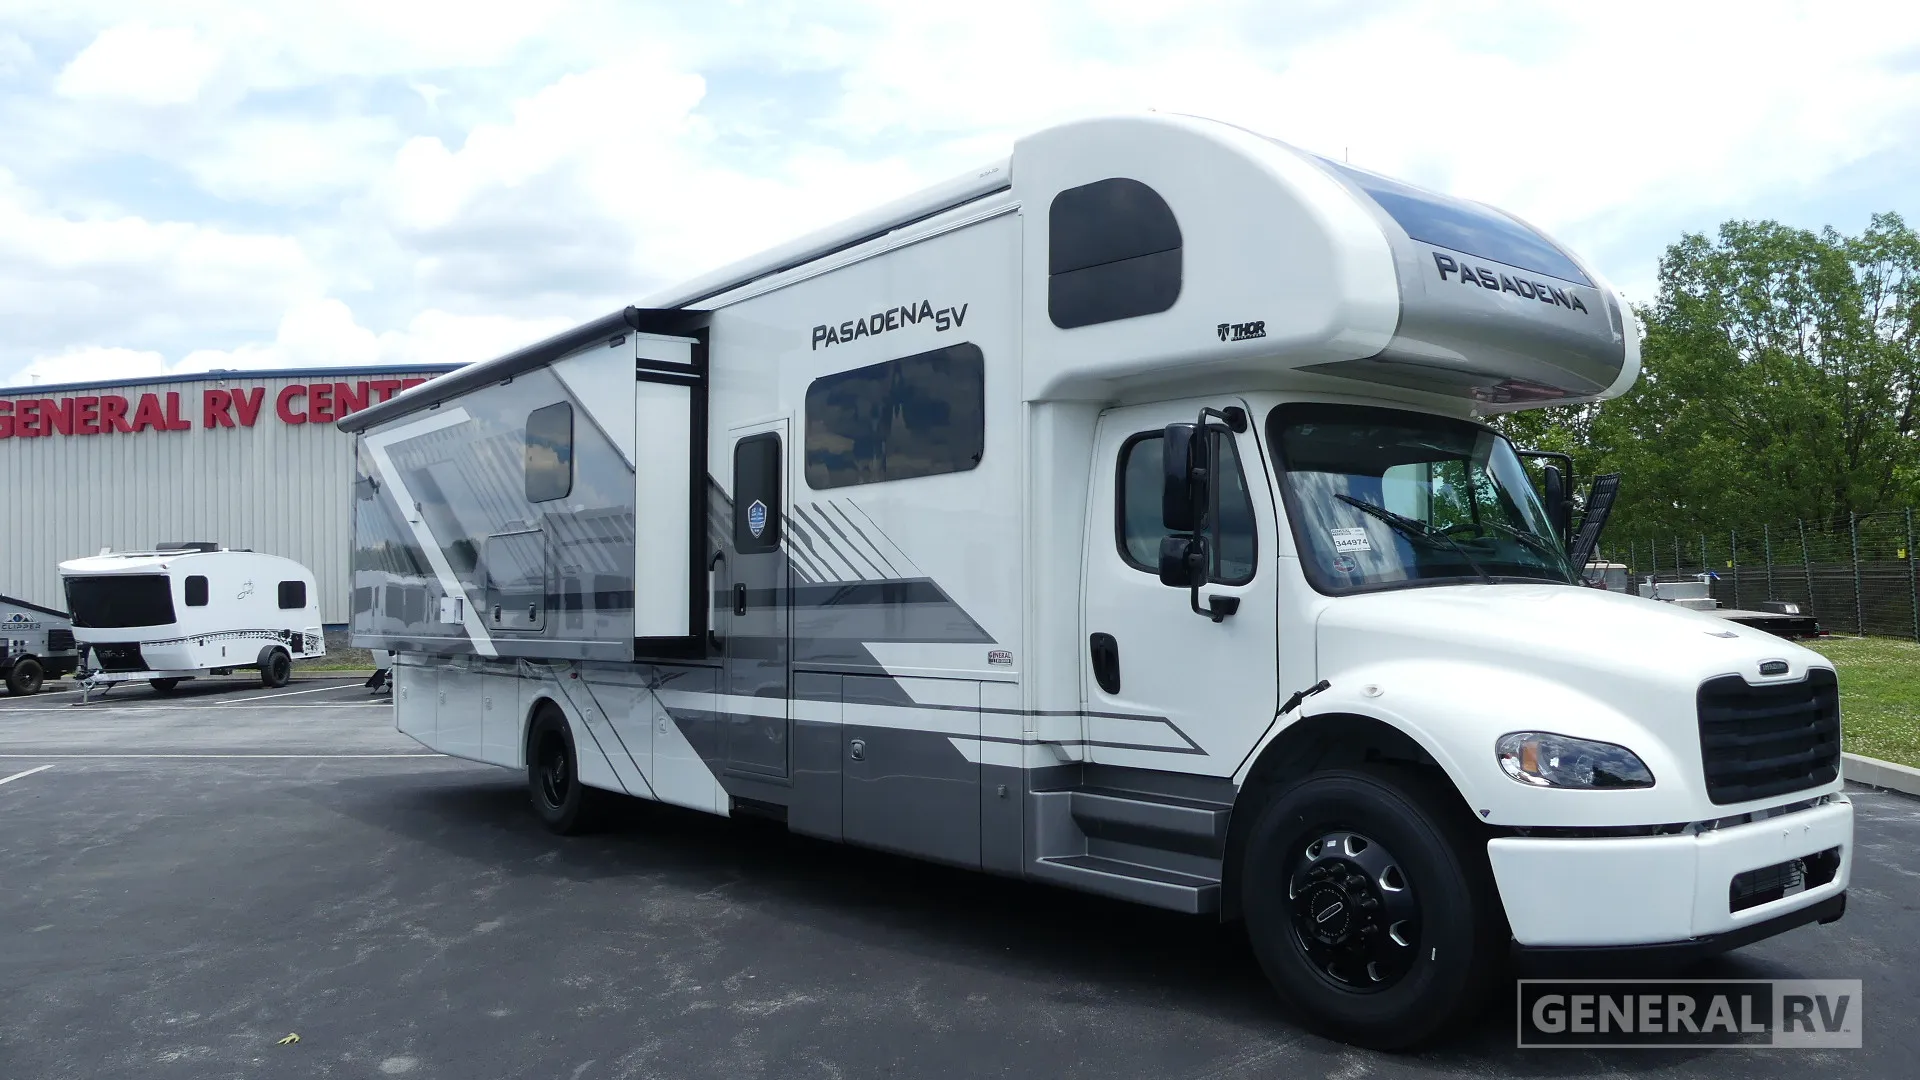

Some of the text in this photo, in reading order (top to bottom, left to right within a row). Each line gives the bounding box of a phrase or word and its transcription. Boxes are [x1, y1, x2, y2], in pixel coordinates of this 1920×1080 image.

[1432, 251, 1588, 315] PASADENA
[811, 299, 969, 351] PASADENA SV
[1231, 320, 1266, 337] THOR
[203, 386, 266, 429] RV
[276, 376, 437, 425] CENT
[1335, 538, 1368, 547] 344974
